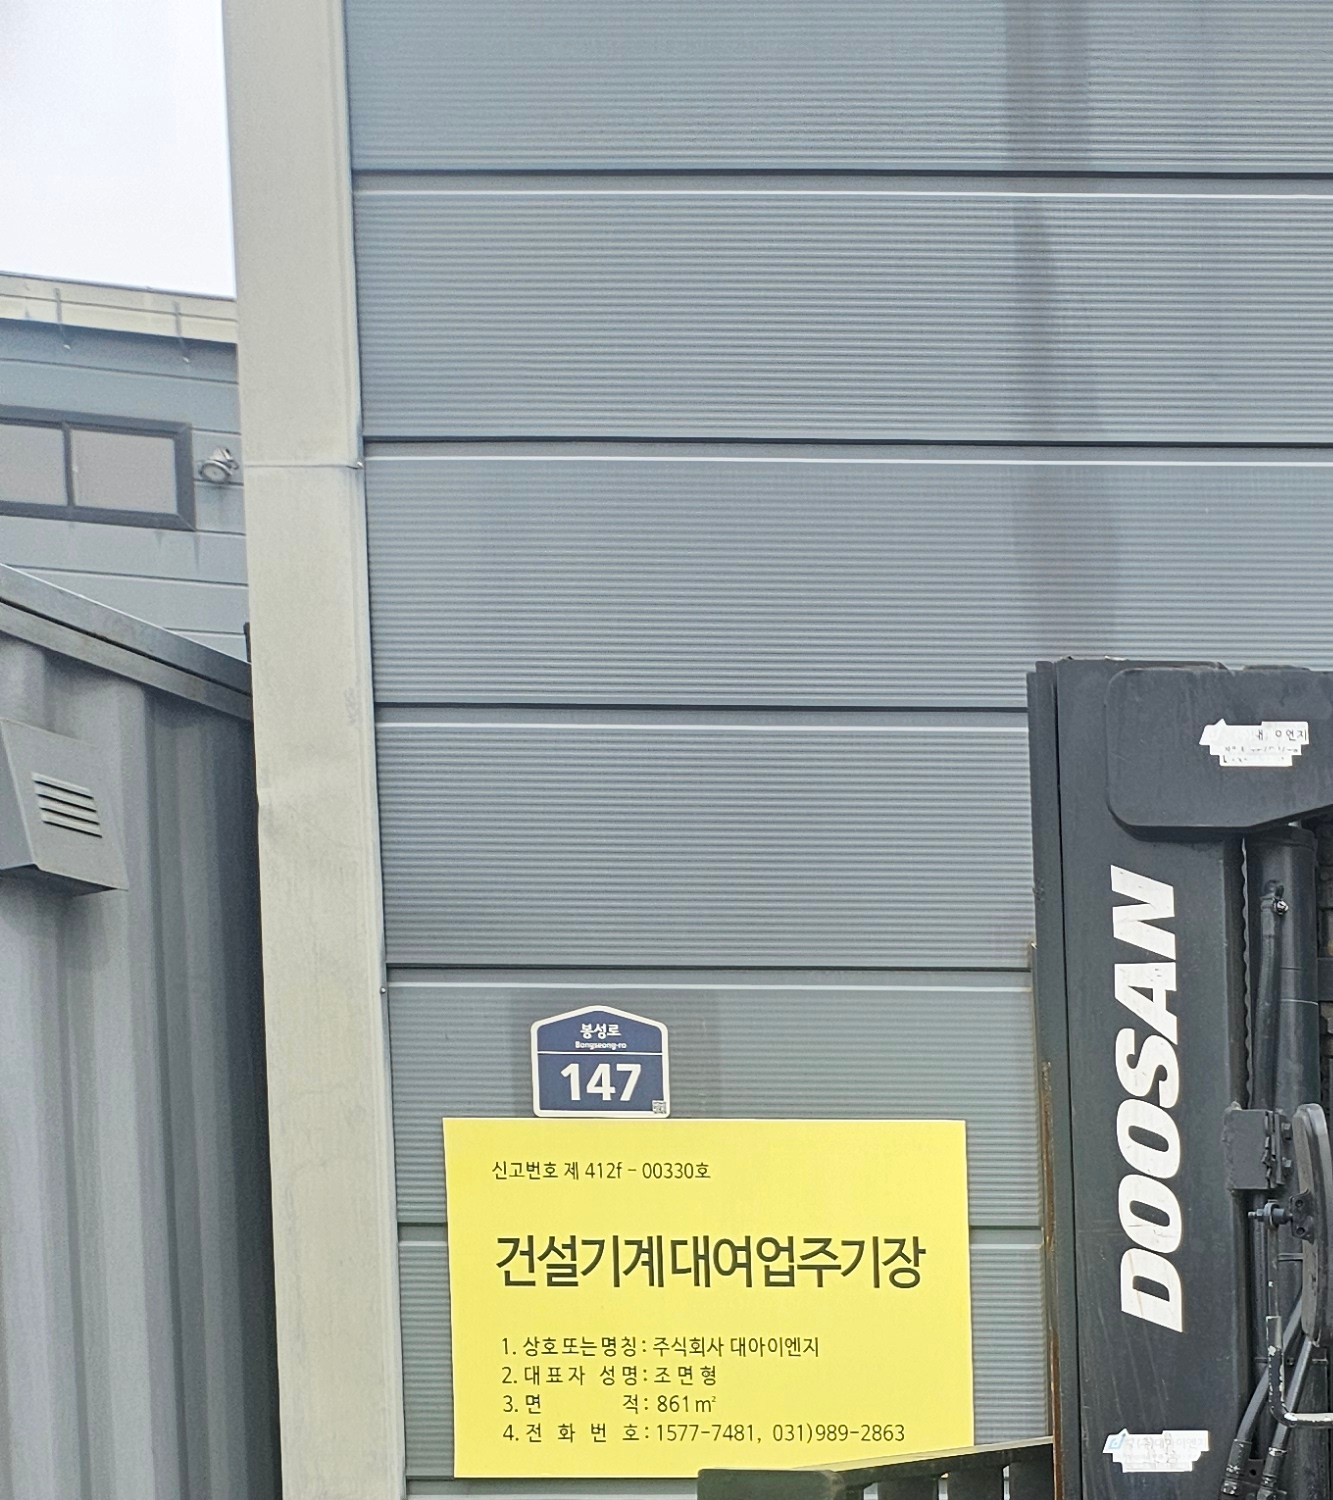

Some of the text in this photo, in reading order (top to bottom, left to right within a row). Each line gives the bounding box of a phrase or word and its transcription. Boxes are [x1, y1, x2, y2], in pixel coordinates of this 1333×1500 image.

[580, 1023, 621, 1039] 봉성로
[575, 1041, 627, 1050] Bongseong-ro
[561, 1063, 641, 1101] 147
[1111, 864, 1183, 1333] DOOSAN
[492, 1161, 558, 1181] 신고번호
[564, 1161, 579, 1180] 제
[585, 1162, 622, 1179] 412f
[642, 1161, 711, 1179] 00330호
[496, 1235, 926, 1289] 건설기계대여업주기장
[501, 1337, 517, 1356] 1.
[652, 1336, 724, 1357] 주식회사
[730, 1336, 819, 1357] 대아이엔지
[501, 1366, 518, 1384] 2.
[503, 1395, 519, 1413] 3.
[525, 1394, 542, 1414] 면
[502, 1424, 519, 1442] 4.
[657, 1424, 761, 1443] 1577-7481,
[773, 1423, 905, 1443] 031)989-2863
